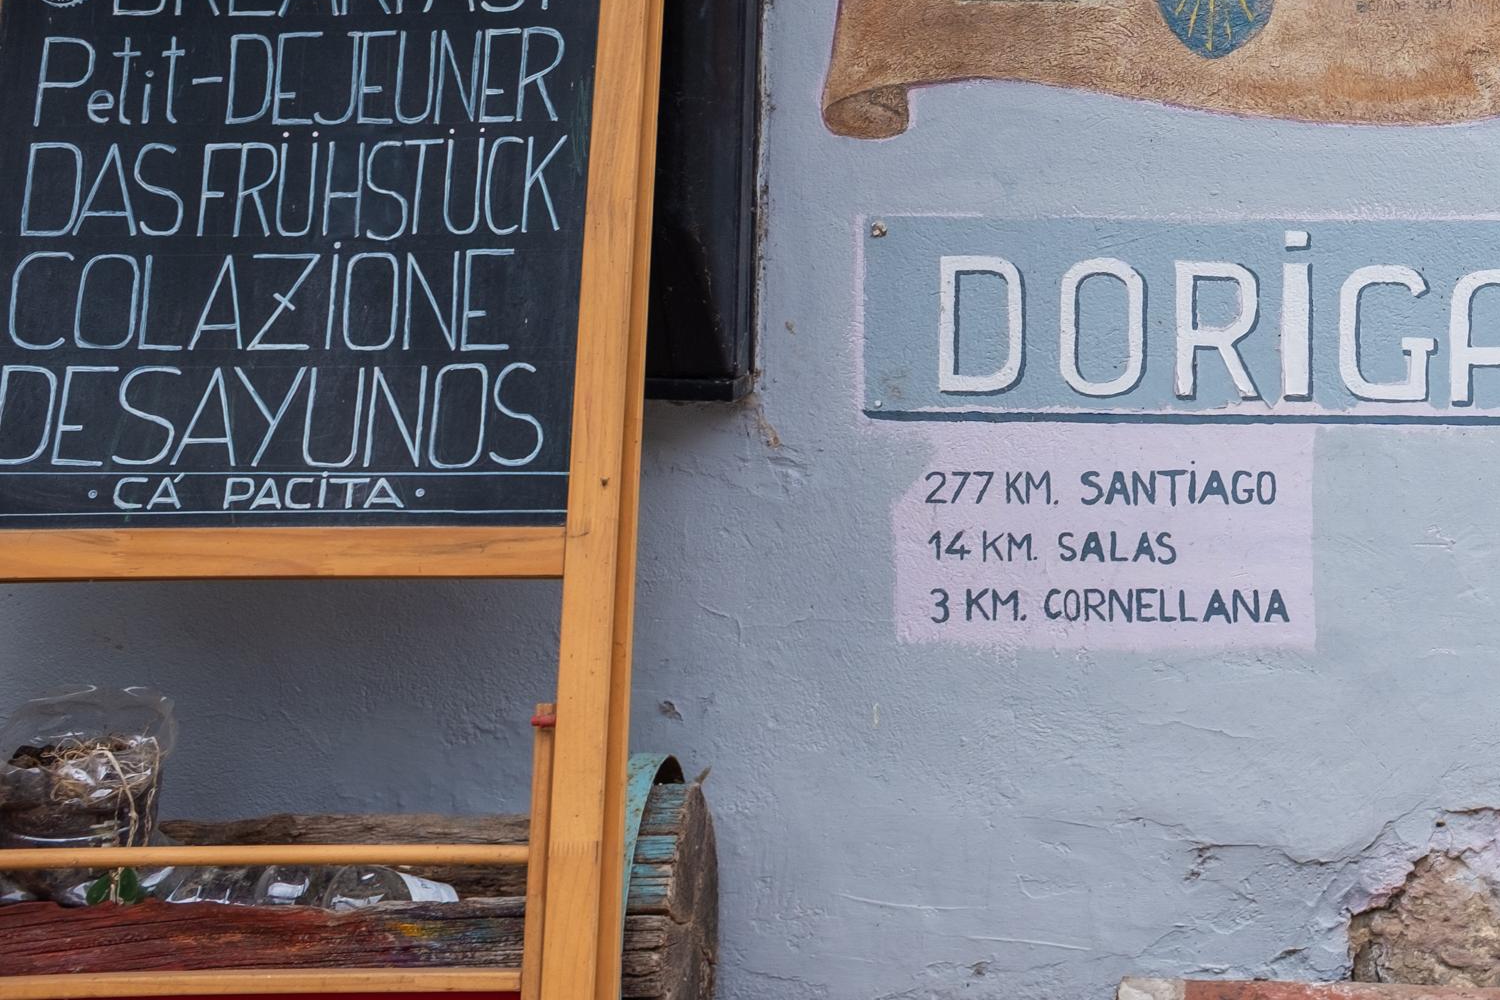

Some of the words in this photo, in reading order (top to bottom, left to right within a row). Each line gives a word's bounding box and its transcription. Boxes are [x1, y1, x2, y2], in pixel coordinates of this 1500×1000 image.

[21, 142, 184, 237] DAS
[197, 127, 568, 240] FRÜHSTÜCK
[0, 362, 545, 468] DESAYUNOS
[223, 470, 405, 511] PACITA
[924, 470, 994, 506] 277
[1005, 471, 1060, 507] KM.
[1080, 460, 1277, 507] SANTIAGO
[927, 530, 972, 563] 14
[982, 531, 1038, 563] KM.
[1058, 530, 1178, 565] SALAS
[930, 588, 951, 625] 3
[964, 588, 1028, 624] KM.
[1043, 587, 1291, 625] CORNELLANA
